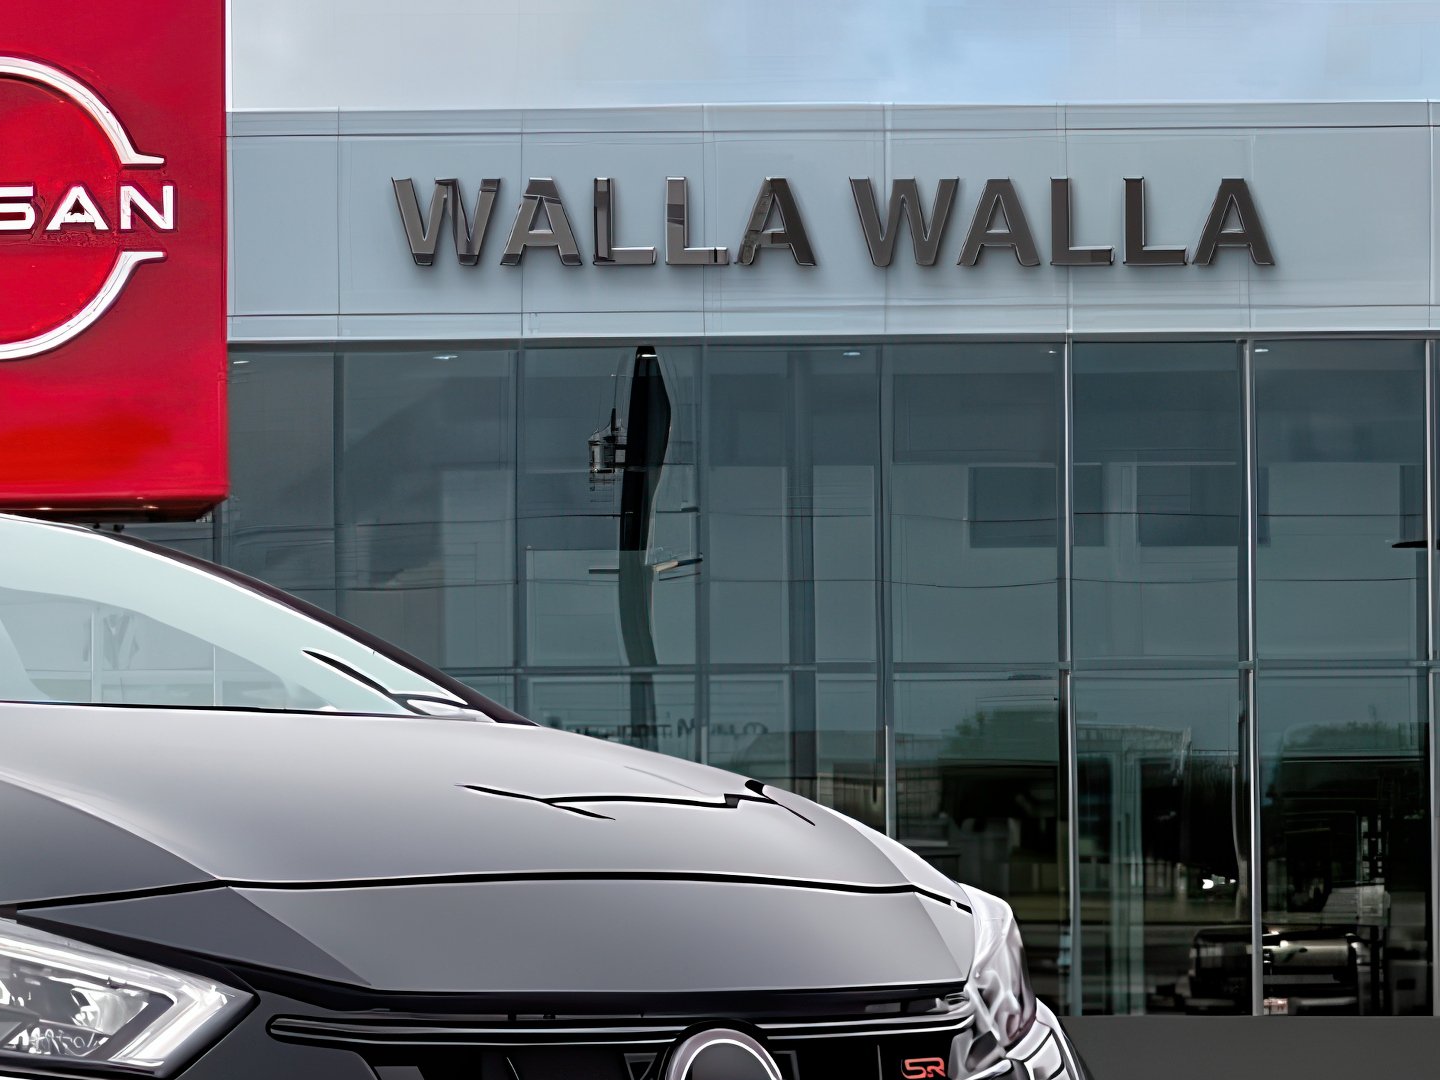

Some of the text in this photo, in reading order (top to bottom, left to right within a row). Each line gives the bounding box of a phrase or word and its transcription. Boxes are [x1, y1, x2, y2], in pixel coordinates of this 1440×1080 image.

[392, 176, 1275, 267] WALLA WALLA
[904, 1057, 946, 1079] SR
